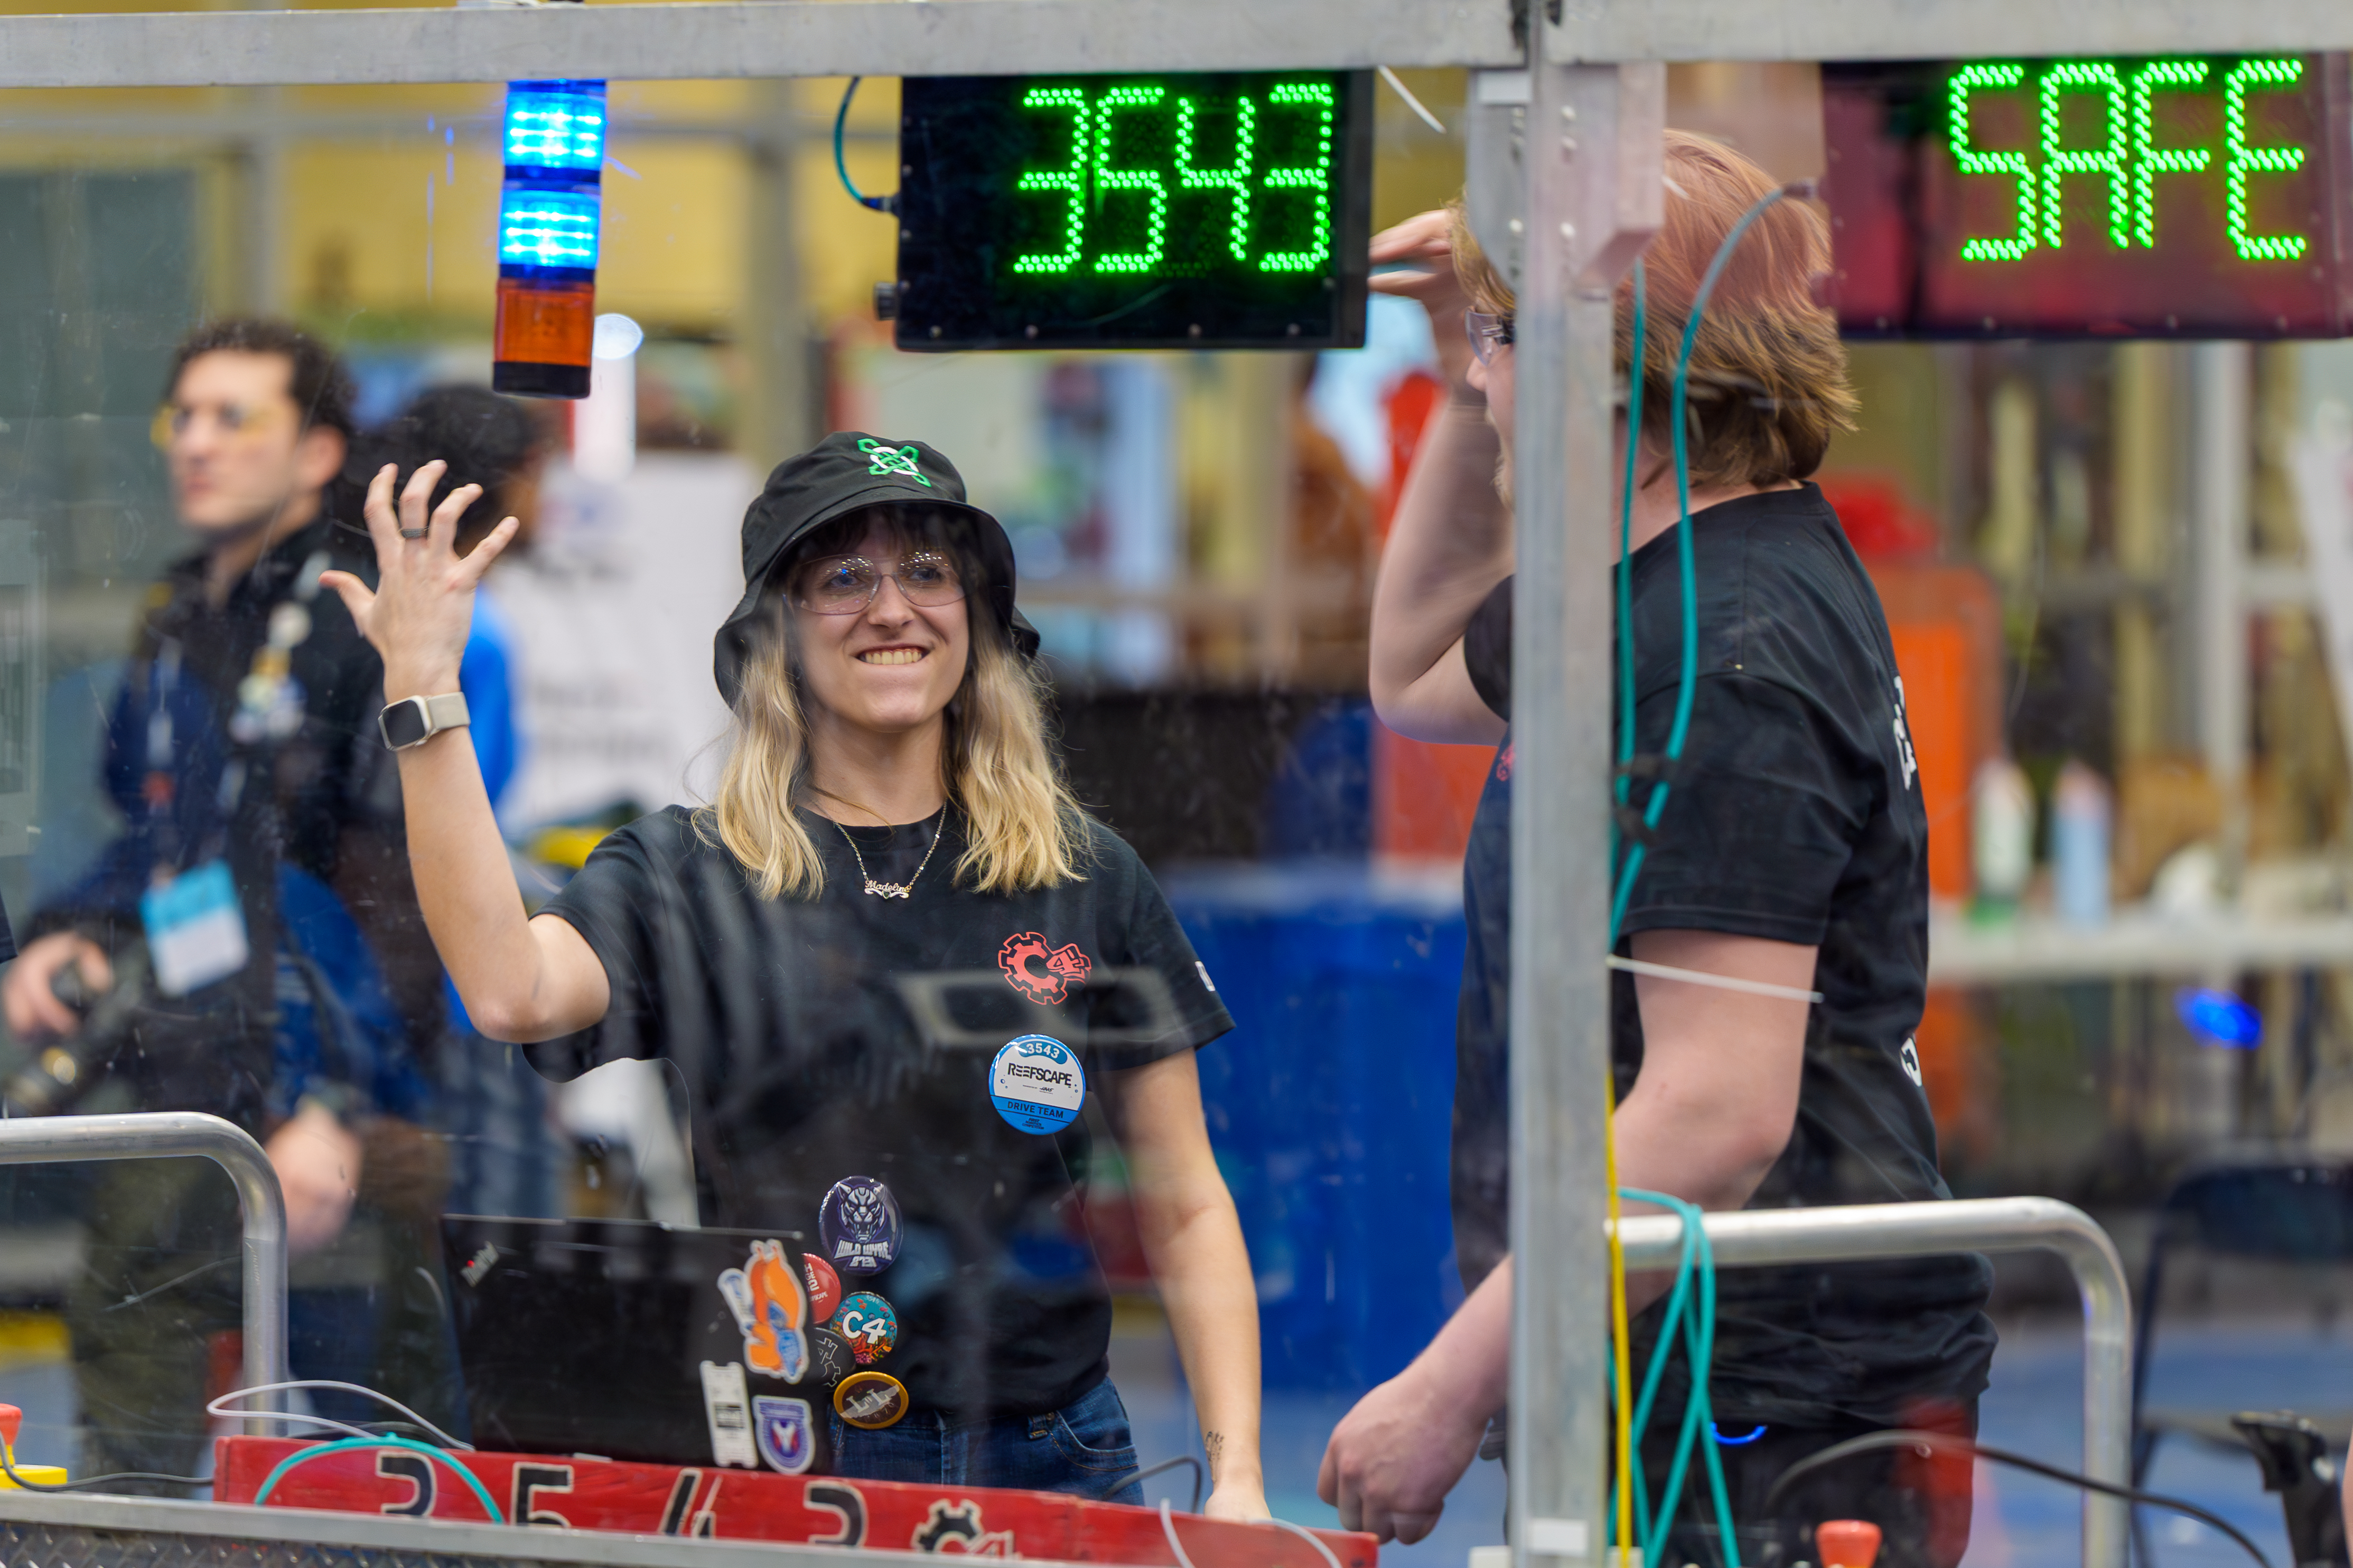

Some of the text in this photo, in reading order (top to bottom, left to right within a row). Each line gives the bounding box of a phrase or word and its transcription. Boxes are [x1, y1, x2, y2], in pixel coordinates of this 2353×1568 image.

[1949, 59, 2306, 261] SAFE
[1013, 83, 1334, 273] 3543
[865, 880, 911, 893] Madeline
[1026, 1043, 1060, 1059] 3543
[1007, 1063, 1072, 1086] REEFSCAPE
[1007, 1101, 1064, 1119] DRIVE TEAM
[834, 1240, 892, 1261] WILD WYRE
[843, 1310, 887, 1344] C4
